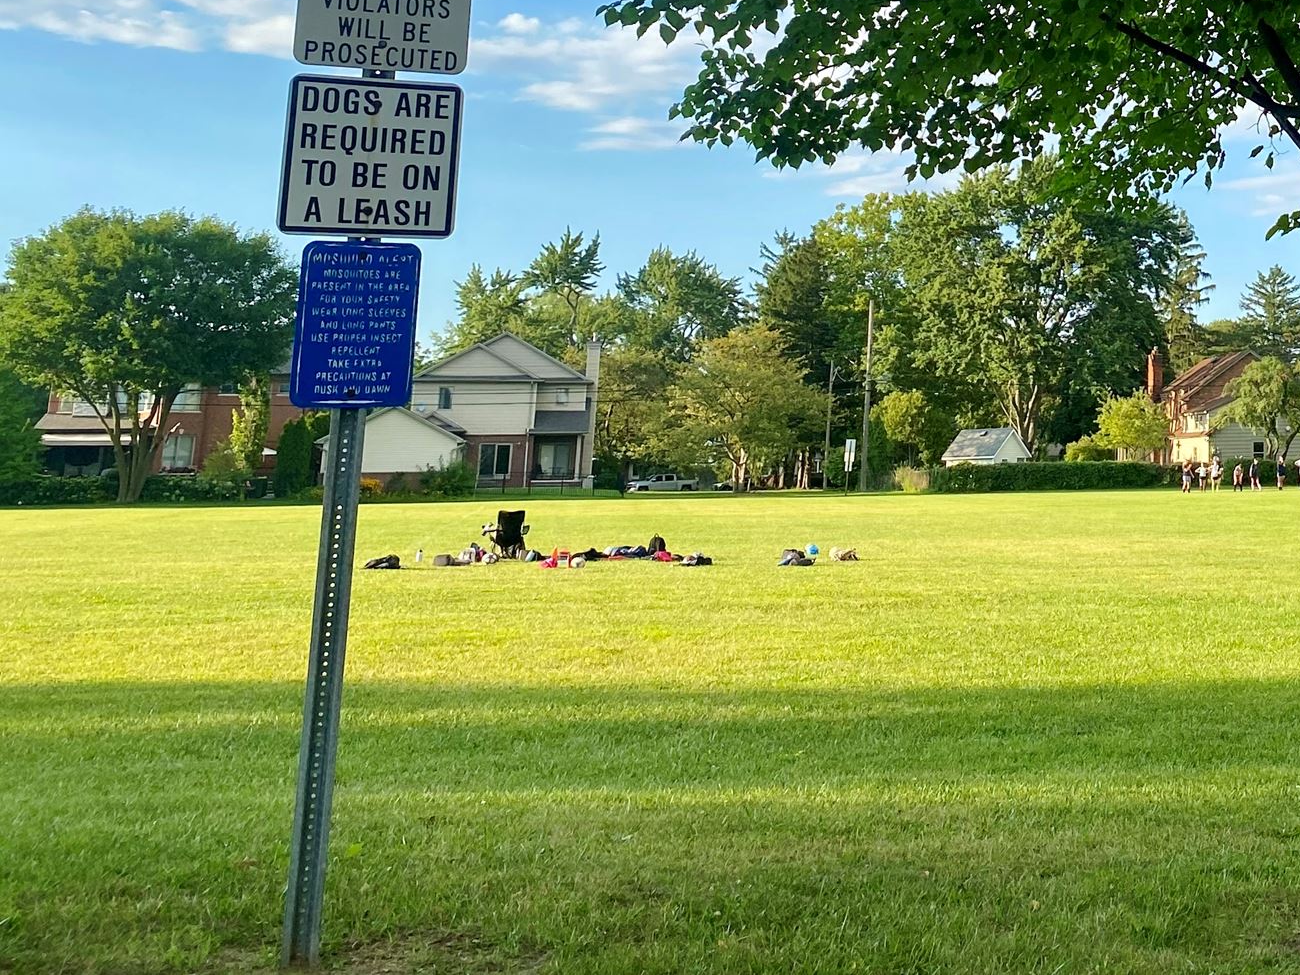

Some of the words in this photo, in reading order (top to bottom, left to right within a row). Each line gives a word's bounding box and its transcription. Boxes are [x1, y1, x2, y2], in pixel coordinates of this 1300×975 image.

[339, 17, 390, 40] WILL
[403, 22, 431, 43] BE
[304, 41, 457, 71] PROSECUTED
[302, 86, 380, 115] DOGS
[394, 93, 449, 119] ARE
[301, 123, 445, 155] REQUIRED
[302, 160, 336, 186] TO
[352, 162, 387, 188] BE
[403, 165, 440, 191] ON
[304, 197, 321, 222] A
[338, 198, 431, 226] LEASH
[324, 269, 380, 279] MOSQUITOES
[385, 270, 400, 279] ARE
[312, 282, 351, 291] PRESENT
[368, 283, 383, 292] THE
[389, 283, 409, 292] AREA
[320, 294, 336, 303] FOR
[341, 295, 362, 303] YOUR
[367, 295, 400, 304] SAFETY
[312, 307, 337, 317] WEAR
[342, 308, 364, 317] LONG
[368, 308, 406, 317] SLEEVES
[320, 321, 337, 329] AND
[342, 321, 364, 330] LONG
[369, 321, 396, 330] PANTS
[311, 333, 328, 342] USE
[333, 334, 366, 342] PROPER
[371, 334, 402, 343] INSECT
[332, 346, 380, 355] REPELLENT
[328, 359, 349, 368] TAKE
[354, 359, 382, 367] EXTRA
[316, 372, 376, 381] PRECAUTIONS
[381, 372, 391, 380] AT
[315, 385, 338, 394] DUSK
[365, 385, 390, 394] DAWN
